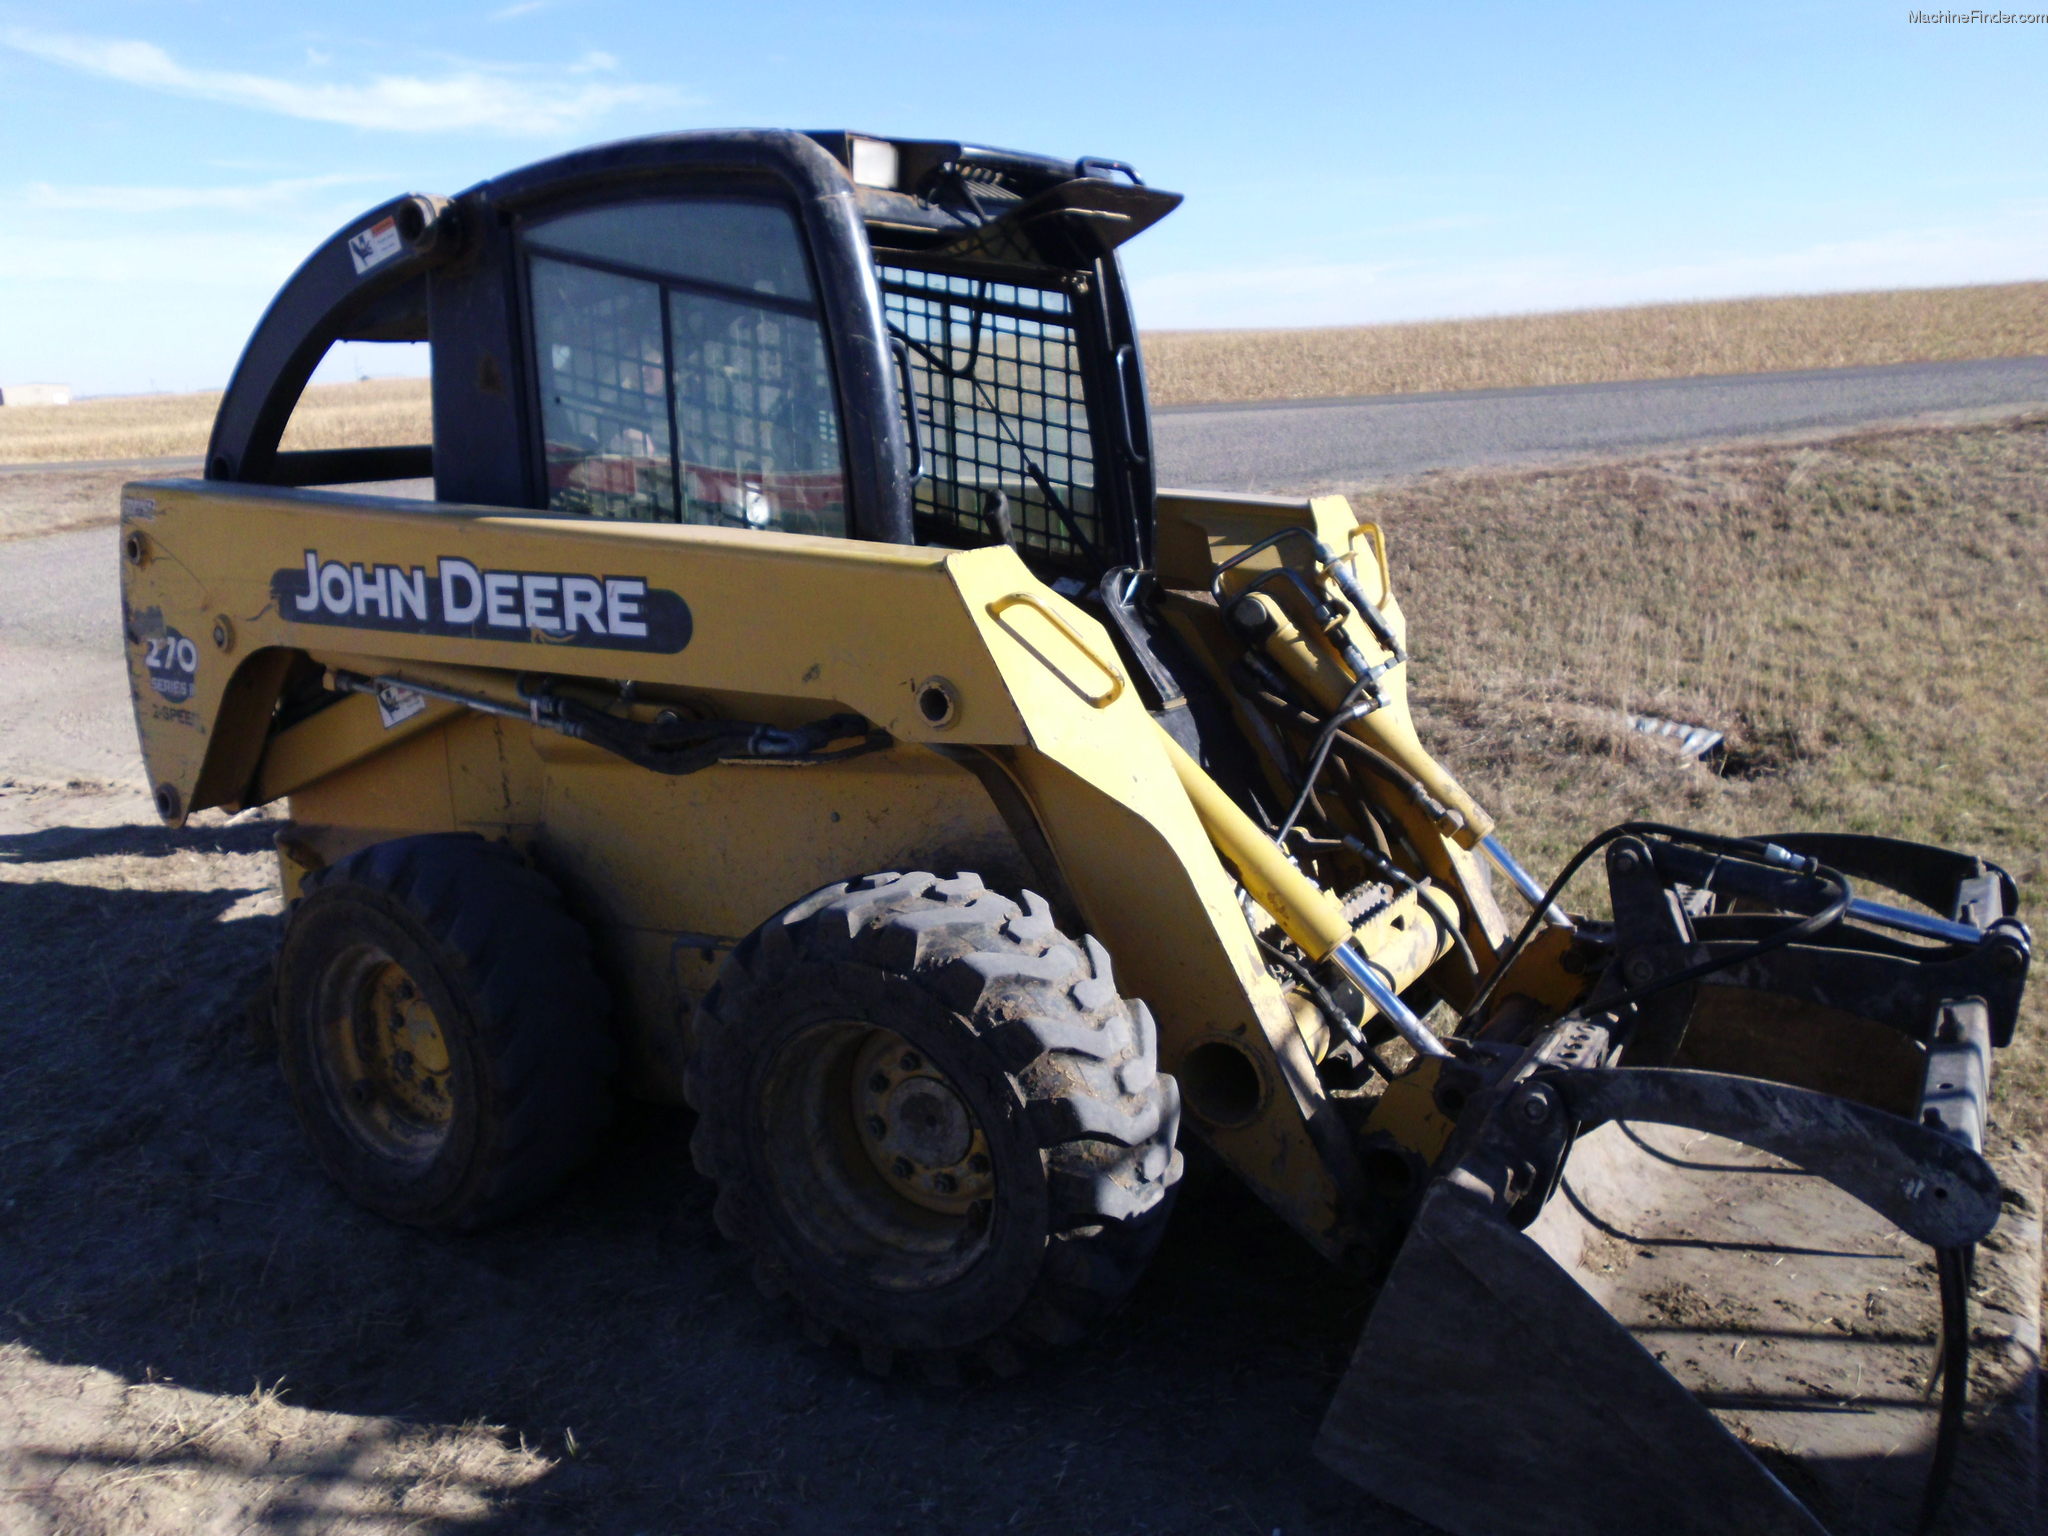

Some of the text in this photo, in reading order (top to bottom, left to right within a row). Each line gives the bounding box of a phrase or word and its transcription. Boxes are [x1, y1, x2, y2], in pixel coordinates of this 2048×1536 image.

[296, 551, 648, 637] JOHN DEERE
[145, 636, 198, 673] 270
